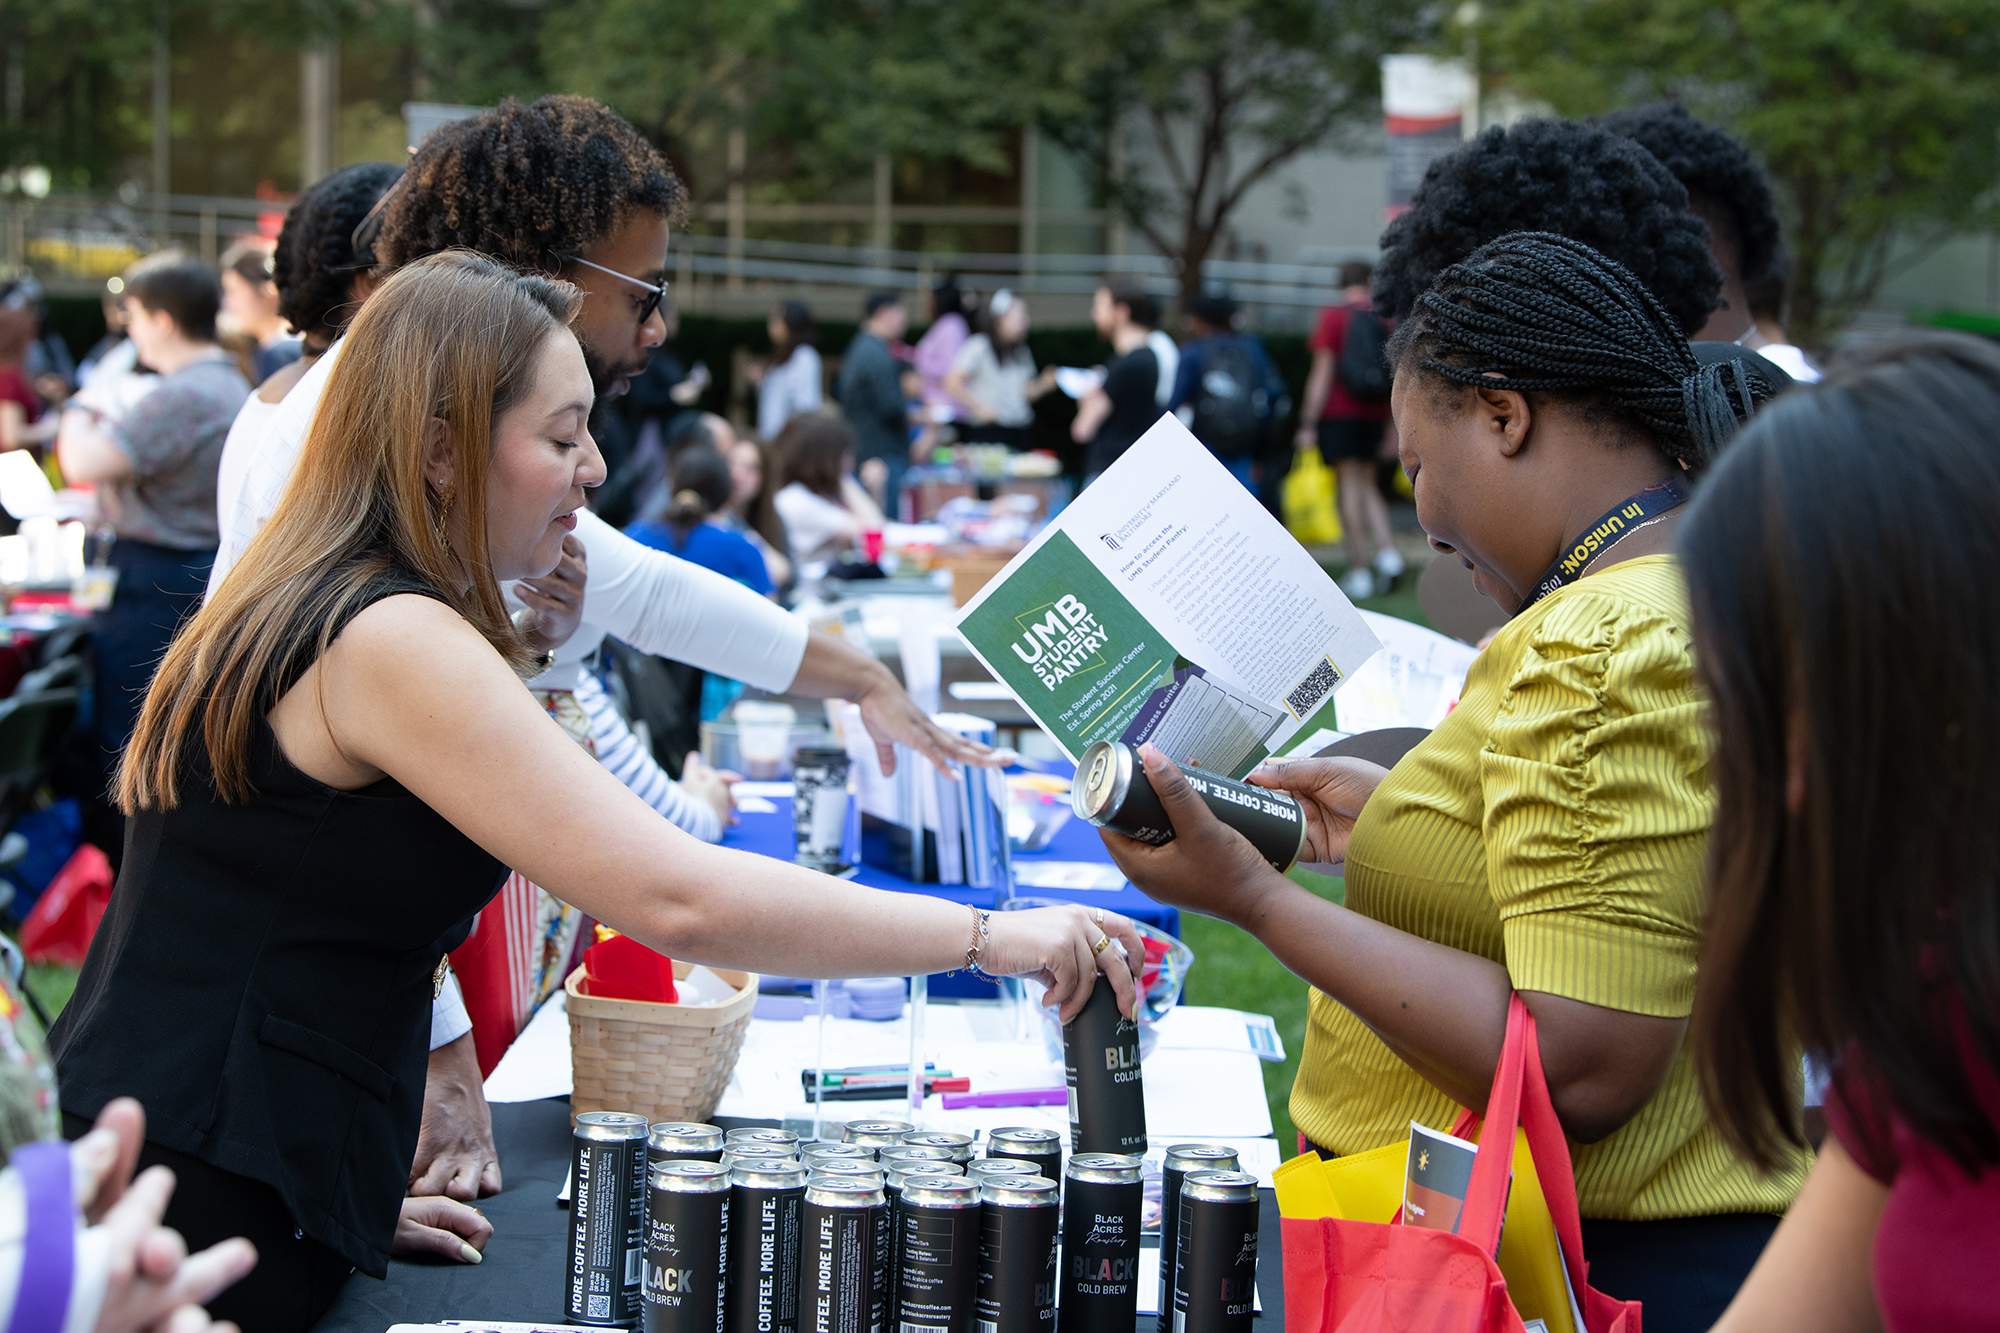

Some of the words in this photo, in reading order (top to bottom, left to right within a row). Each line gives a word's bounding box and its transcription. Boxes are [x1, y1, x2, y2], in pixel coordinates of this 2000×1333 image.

[1114, 508, 1147, 538] UNIVERSITY
[1149, 475, 1181, 505] MARYLAND
[1621, 502, 1645, 520] In
[1119, 512, 1152, 543] BALTIMORE
[1560, 516, 1626, 576] UniSON:
[1120, 561, 1135, 573] How
[1134, 553, 1142, 561] to
[1143, 534, 1162, 554] access
[1161, 524, 1172, 535] the
[1128, 567, 1143, 581] UMB
[1142, 545, 1167, 568] Student
[1166, 526, 1187, 546] Pantry:
[1151, 574, 1168, 589] Place
[1167, 567, 1175, 575] an
[1175, 550, 1192, 567] online
[1192, 536, 1207, 551] order
[1206, 527, 1215, 536] for
[1215, 513, 1230, 528] food
[1166, 579, 1192, 603] scanning
[1190, 570, 1200, 580] the
[1200, 560, 1210, 571] QR
[1210, 547, 1224, 562] code
[1223, 531, 1241, 548] below
[1177, 557, 1199, 579] hygiene
[1200, 543, 1215, 558] items
[1214, 535, 1223, 543] by
[1174, 599, 1185, 611] and
[1183, 584, 1201, 600] filling
[1200, 574, 1211, 586] out
[1209, 566, 1219, 576] the
[1219, 549, 1237, 566] online
[1235, 536, 1250, 549] form.
[1011, 594, 1087, 663] UMB
[1033, 613, 1097, 677] STUDENT
[1042, 624, 1108, 691] PANTRY
[1059, 710, 1073, 722] The
[1071, 686, 1098, 711] Student
[1096, 663, 1124, 688] Success
[1122, 642, 1145, 664] Center
[1067, 719, 1081, 731] Est.
[1079, 699, 1103, 720] Spring
[1100, 684, 1117, 701] 2021
[1082, 738, 1093, 748] The
[1092, 726, 1106, 739] UMB
[1104, 709, 1125, 728] Student
[1123, 694, 1141, 711] Pantry
[1140, 674, 1163, 696] provides
[1116, 717, 1129, 730] food
[1129, 708, 1140, 719] and
[1136, 710, 1161, 742] Success
[1159, 681, 1180, 709] Center
[1210, 782, 1260, 810] COFFEE.
[1262, 802, 1298, 823] MORE
[1114, 1072, 1134, 1084] COLD
[1121, 1138, 1128, 1146] 12
[580, 1146, 590, 1180] LIFE.
[577, 1180, 589, 1218] MORE
[720, 1198, 730, 1233] LIFE.
[762, 1196, 776, 1231] LIFE.
[652, 1219, 676, 1232] BLACK
[652, 1230, 676, 1242] ACRES
[820, 1214, 834, 1250] LIFE.
[1092, 1224, 1124, 1234] ACRES
[1094, 1214, 1124, 1224] BLACK
[574, 1221, 586, 1274] COFFEE.
[648, 1239, 680, 1256] Roastery
[718, 1235, 728, 1274] MORE
[760, 1234, 774, 1272] MORE
[1085, 1232, 1128, 1247] Roastery
[648, 1262, 693, 1293] LACK
[818, 1251, 832, 1292] MORE
[1072, 1255, 1135, 1282] BLACK
[572, 1276, 584, 1314] MORE
[656, 1294, 682, 1306] BREW
[716, 1276, 726, 1333] COFFEE.
[758, 1275, 774, 1332] COFFEE.
[901, 1300, 952, 1311] blackacrescoffee.com
[1078, 1282, 1100, 1294] COLD
[1102, 1285, 1128, 1295] BREW
[816, 1294, 830, 1333] FFEE.
[1227, 1304, 1247, 1315] COLD
